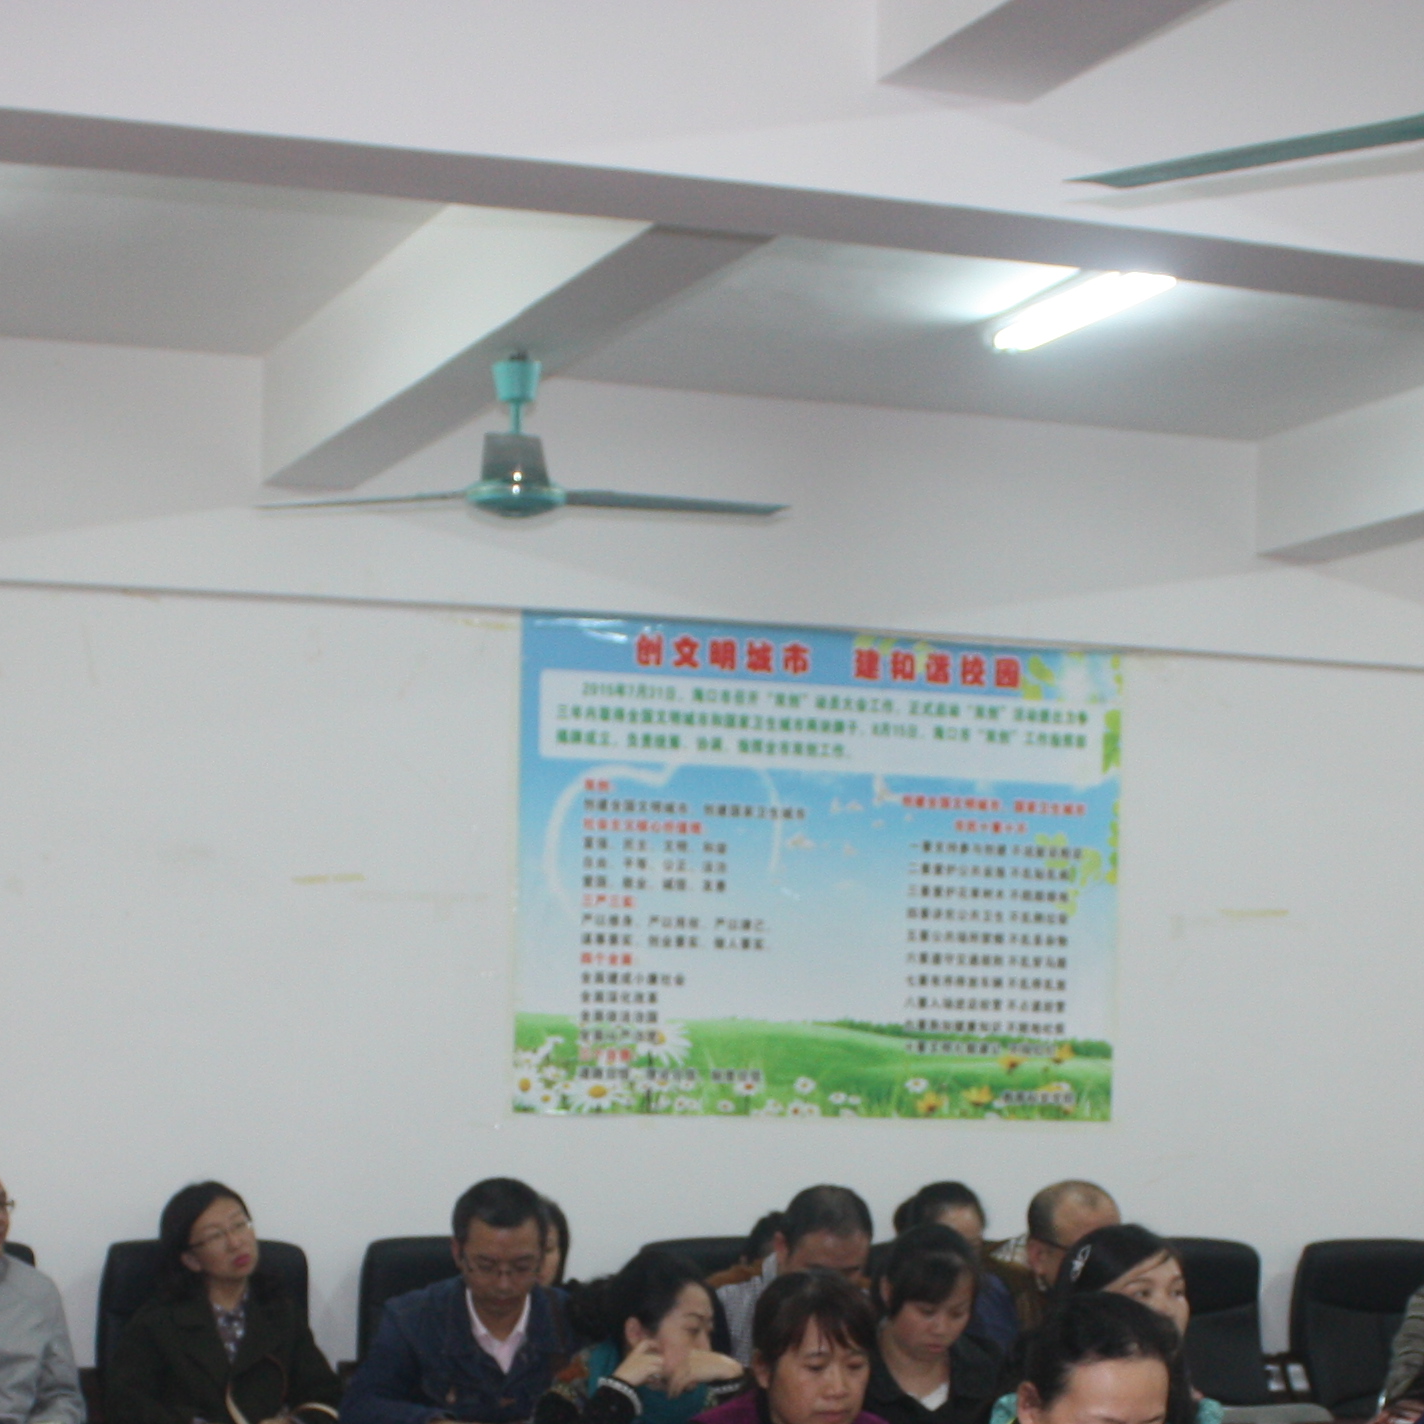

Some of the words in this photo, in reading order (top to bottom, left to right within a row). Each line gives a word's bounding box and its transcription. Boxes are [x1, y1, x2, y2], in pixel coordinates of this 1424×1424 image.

[635, 633, 810, 674] 创文明城市
[853, 648, 1021, 689] 建和谐校园
